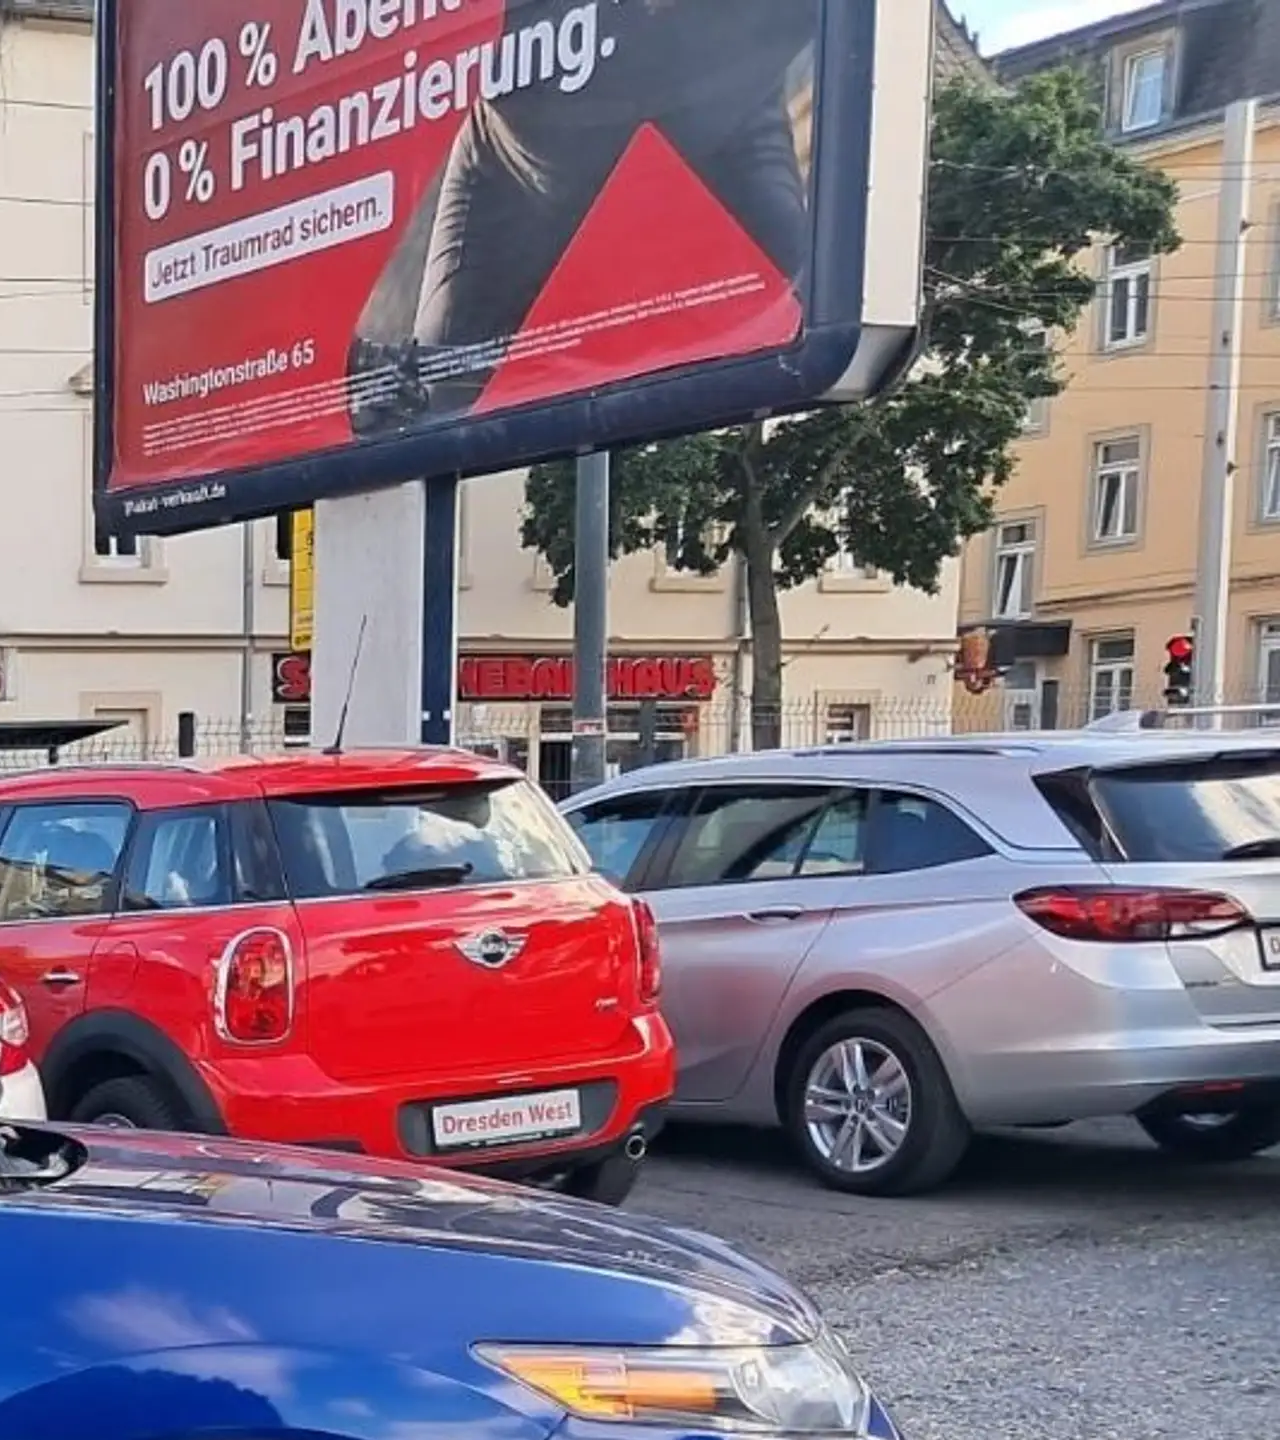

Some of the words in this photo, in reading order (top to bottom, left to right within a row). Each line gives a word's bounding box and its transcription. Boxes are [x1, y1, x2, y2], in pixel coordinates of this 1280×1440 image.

[144, 38, 228, 130] 100
[239, 22, 277, 87] %
[144, 152, 170, 220] 0
[178, 139, 215, 202] %
[230, 3, 616, 191] Finanzierung.
[151, 253, 196, 289] Jetzt
[202, 216, 294, 272] Traumrad
[300, 195, 383, 241] sichern.
[143, 348, 288, 405] Washingtonstraße
[291, 338, 315, 368] 65
[442, 1107, 524, 1134] Dresden
[528, 1100, 573, 1124] West
